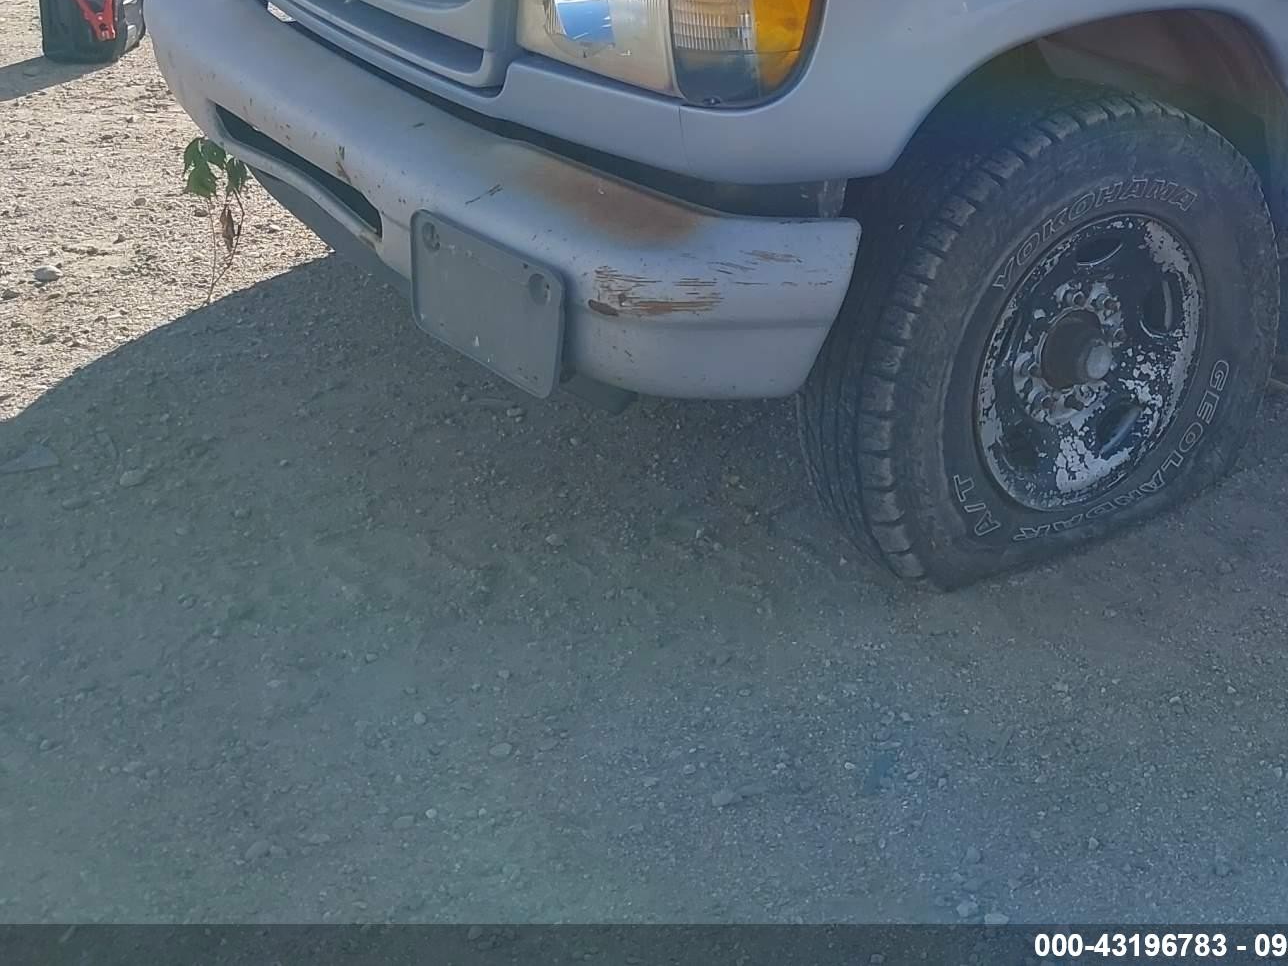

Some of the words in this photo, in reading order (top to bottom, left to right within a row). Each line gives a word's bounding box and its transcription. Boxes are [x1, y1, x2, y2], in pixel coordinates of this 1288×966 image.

[992, 176, 1199, 292] YOKOHAMA
[952, 473, 1001, 538] A/T
[1011, 358, 1230, 542] GEOLANDAR
